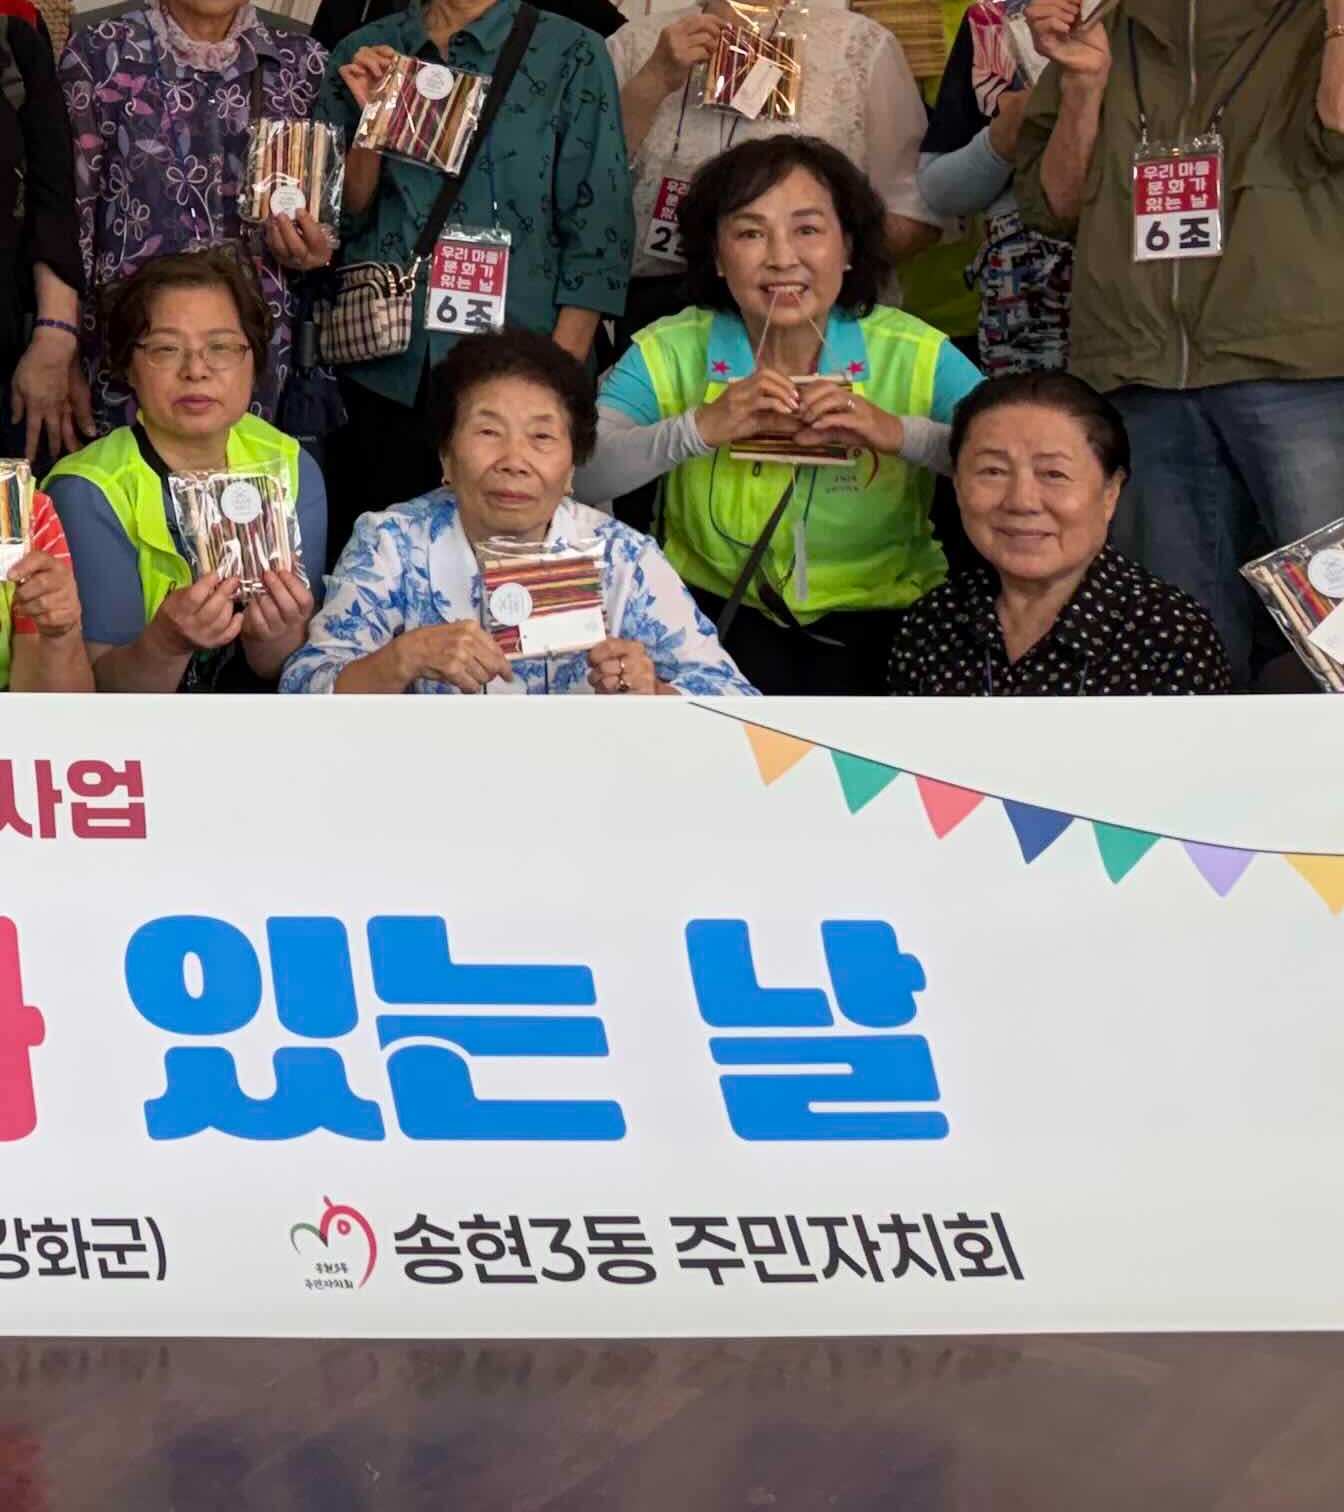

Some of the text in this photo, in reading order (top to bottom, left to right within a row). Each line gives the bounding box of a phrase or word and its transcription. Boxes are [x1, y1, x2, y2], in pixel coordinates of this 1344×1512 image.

[1144, 164, 1174, 179] 우리
[441, 246, 468, 261] 우리
[125, 915, 626, 1141] 있는
[685, 919, 949, 1141] 날
[394, 1212, 1024, 1285] 송현3동 주민자치회
